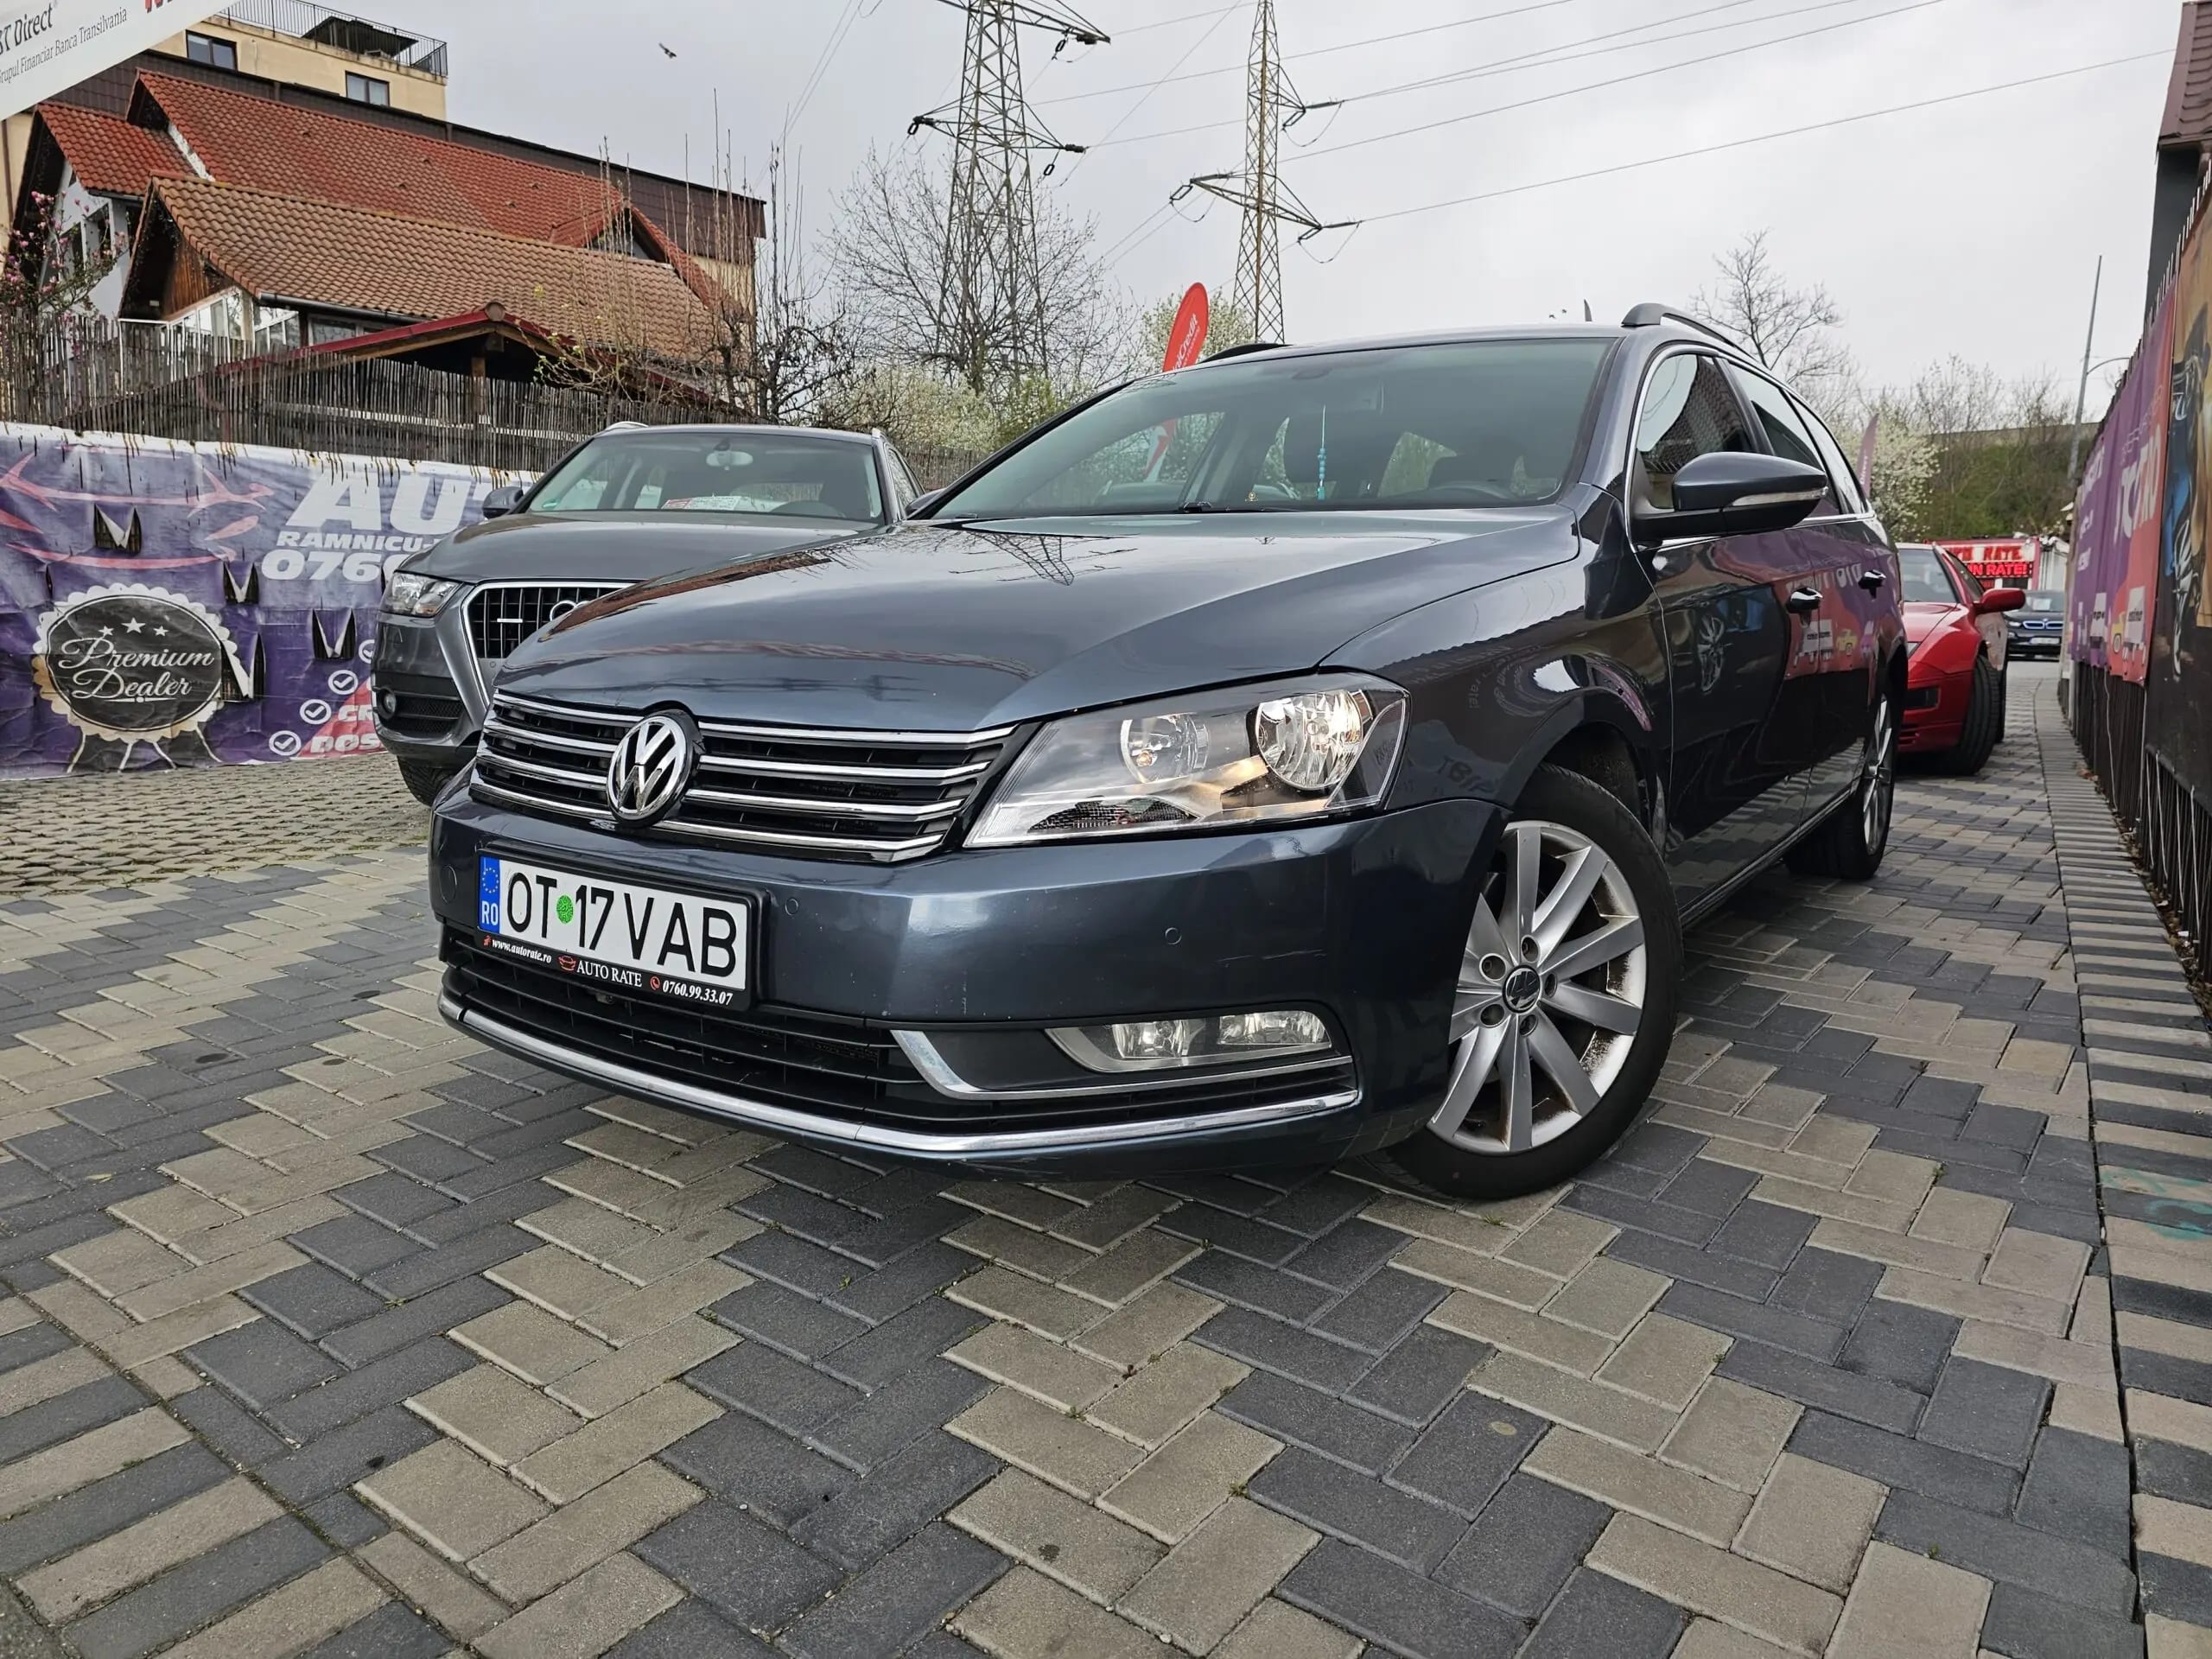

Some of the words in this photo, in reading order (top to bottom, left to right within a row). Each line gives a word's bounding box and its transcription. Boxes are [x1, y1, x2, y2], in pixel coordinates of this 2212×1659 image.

[0, 59, 20, 84] rupul
[21, 44, 54, 73] Financiar
[55, 34, 78, 55] Banca
[79, 6, 128, 44] Transilvania
[14, 6, 53, 47] Direct
[58, 636, 215, 669] Premium
[72, 668, 192, 699] Dealer
[481, 900, 499, 926] RO
[507, 872, 557, 938] OT
[575, 884, 614, 950] 17
[624, 892, 737, 977] VAB
[492, 938, 552, 964] www.autorate.ro
[576, 960, 609, 980] AUTO
[611, 967, 643, 988] RATE
[662, 979, 734, 1006] 0760.99.33.07
